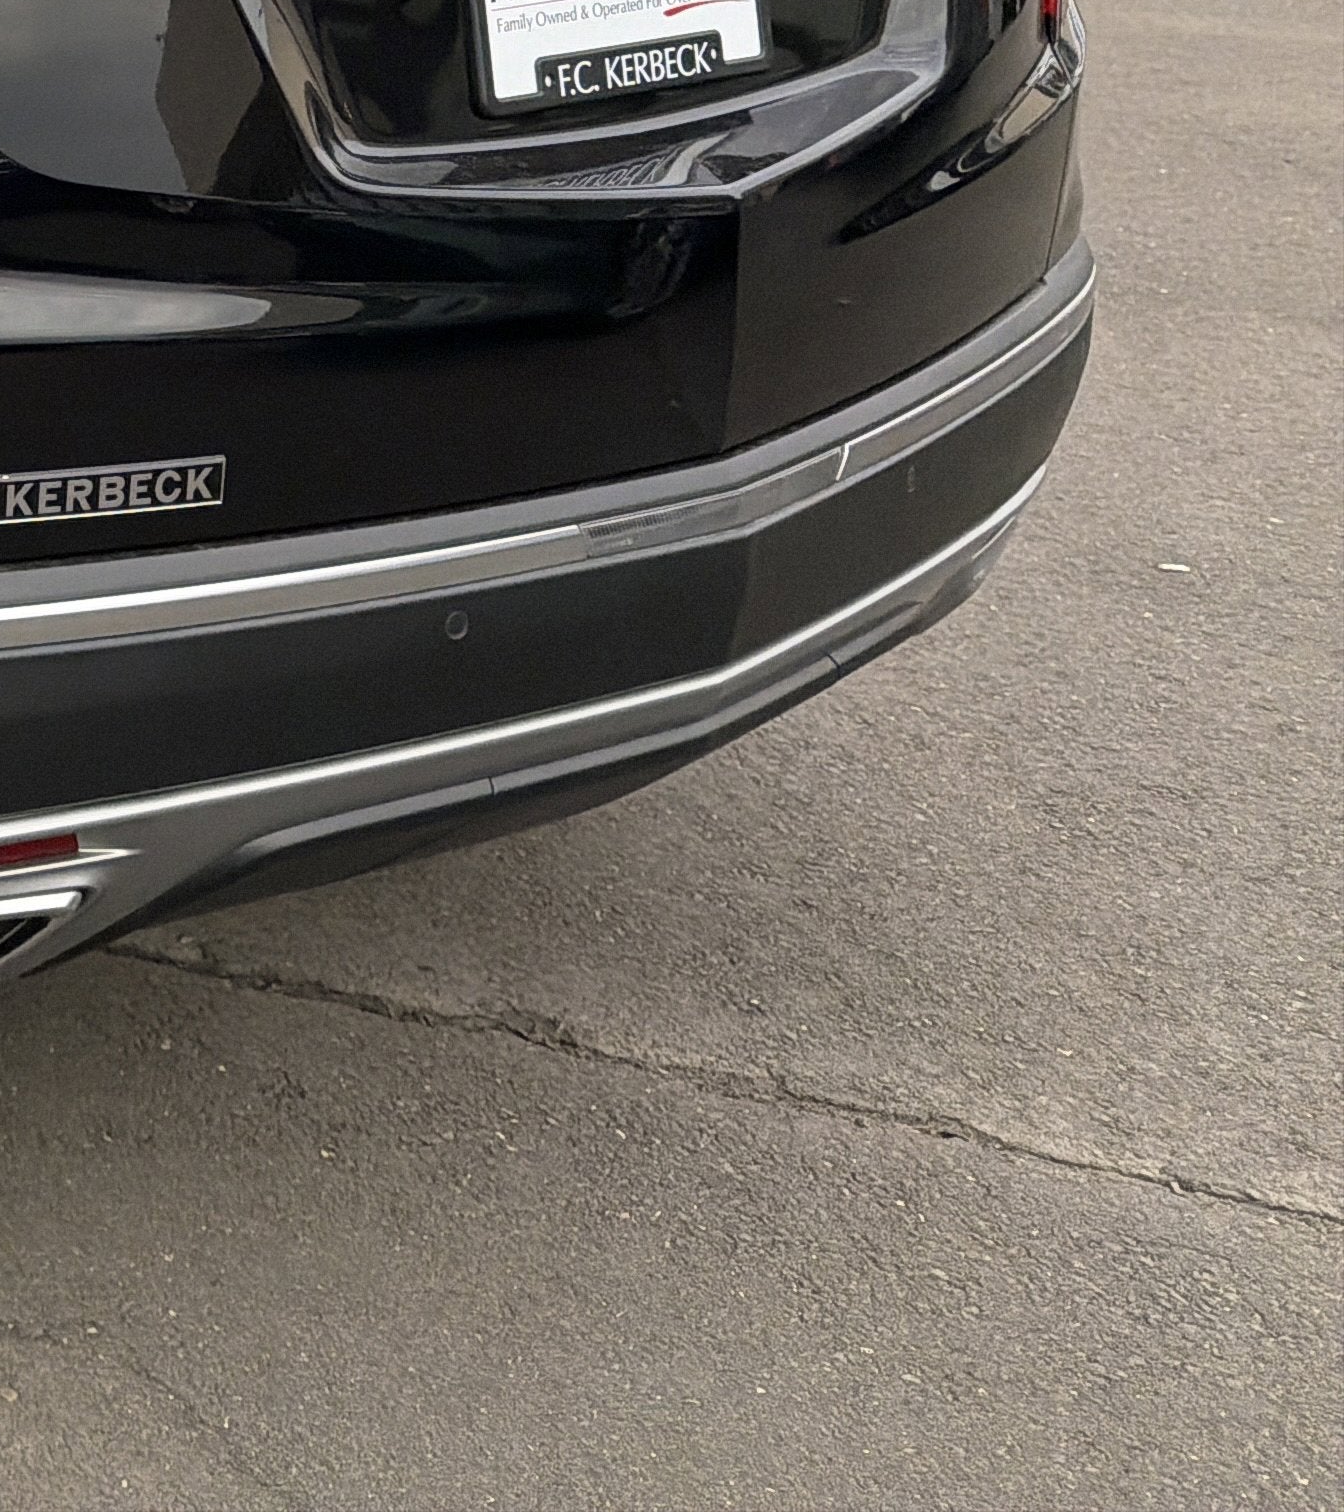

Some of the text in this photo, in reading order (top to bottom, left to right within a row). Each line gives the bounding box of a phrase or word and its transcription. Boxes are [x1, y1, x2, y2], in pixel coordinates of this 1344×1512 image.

[496, 13, 533, 33] Family
[535, 2, 578, 27] Owned
[580, 5, 590, 20] &
[557, 41, 712, 97] F.C. KERBECK
[4, 465, 215, 518] KERBECK
